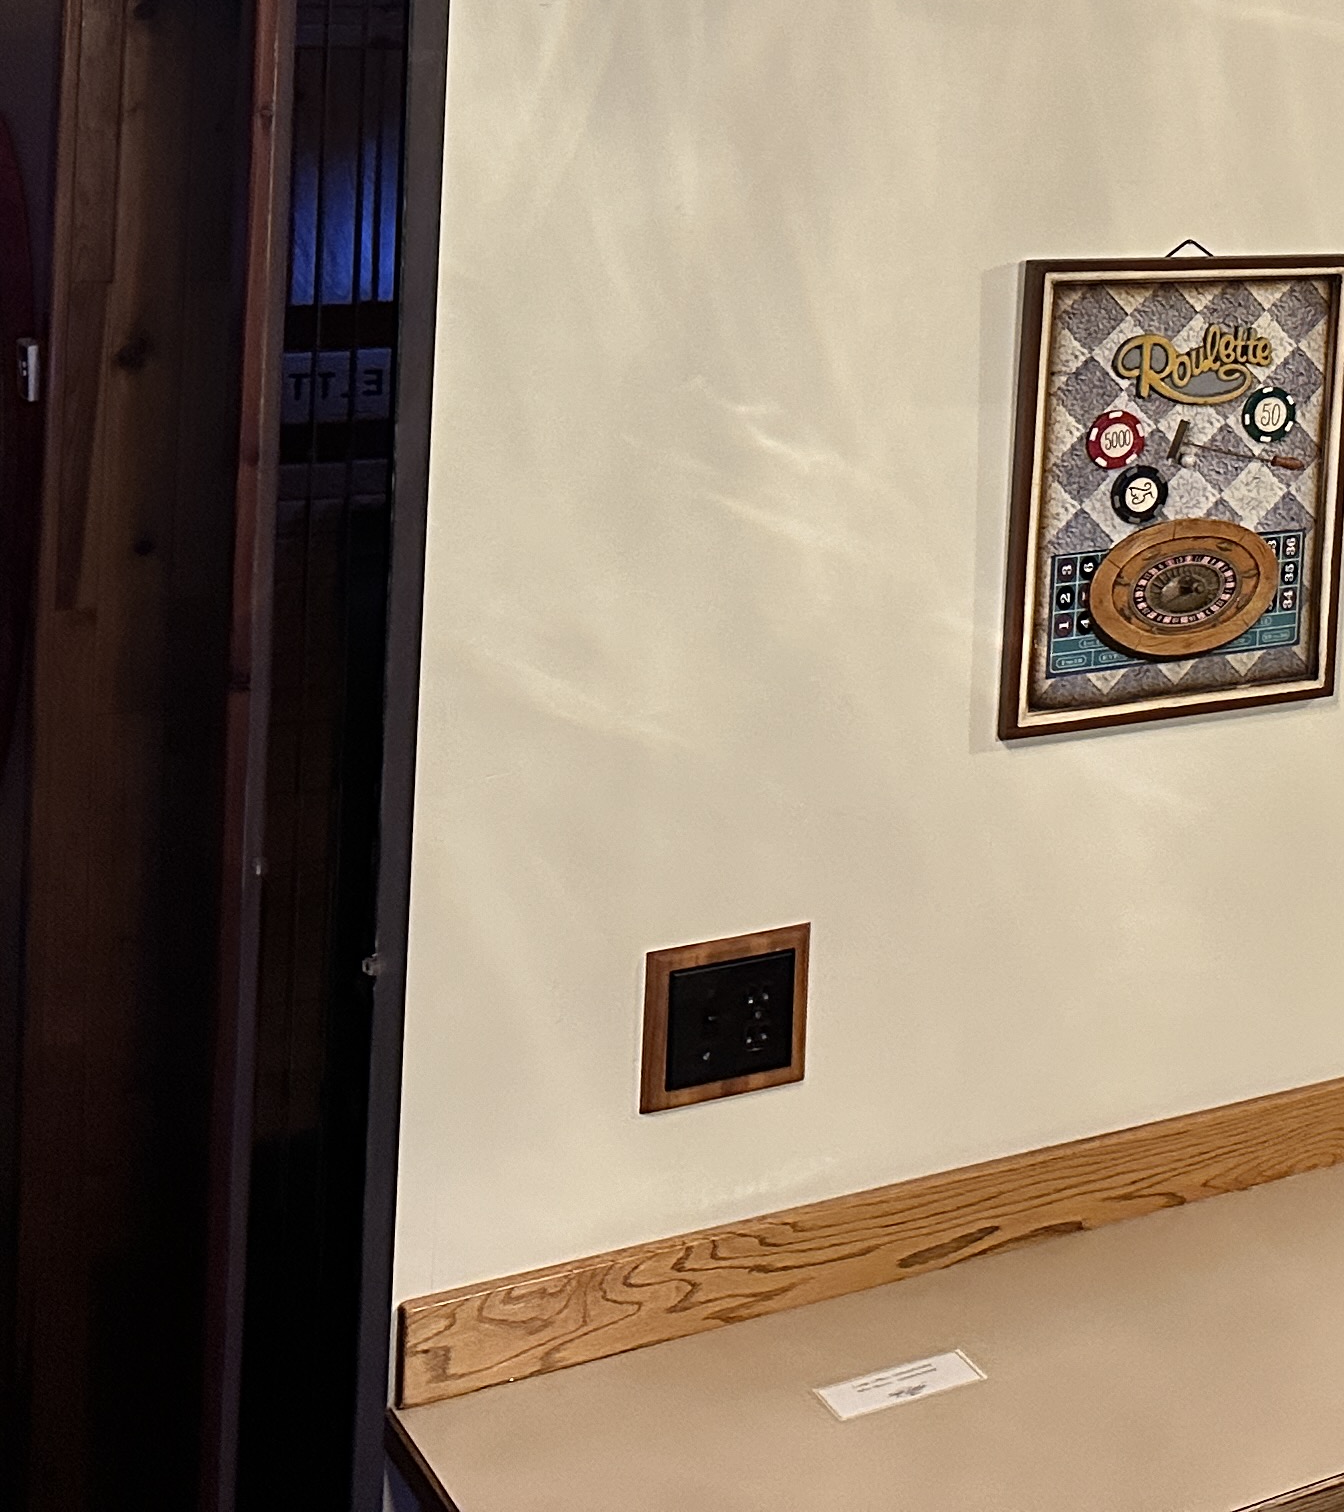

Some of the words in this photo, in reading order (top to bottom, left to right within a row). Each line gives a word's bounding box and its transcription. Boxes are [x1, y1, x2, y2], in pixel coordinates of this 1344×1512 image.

[1111, 322, 1273, 406] Roulette
[1259, 401, 1282, 428] 50
[1103, 428, 1132, 451] 5000
[1285, 536, 1297, 556] 36
[1061, 564, 1073, 576] 3
[1083, 561, 1094, 573] 6
[1284, 562, 1295, 582] 35
[1059, 591, 1071, 604] 2
[1282, 589, 1294, 609] 34
[1058, 620, 1070, 630] 1
